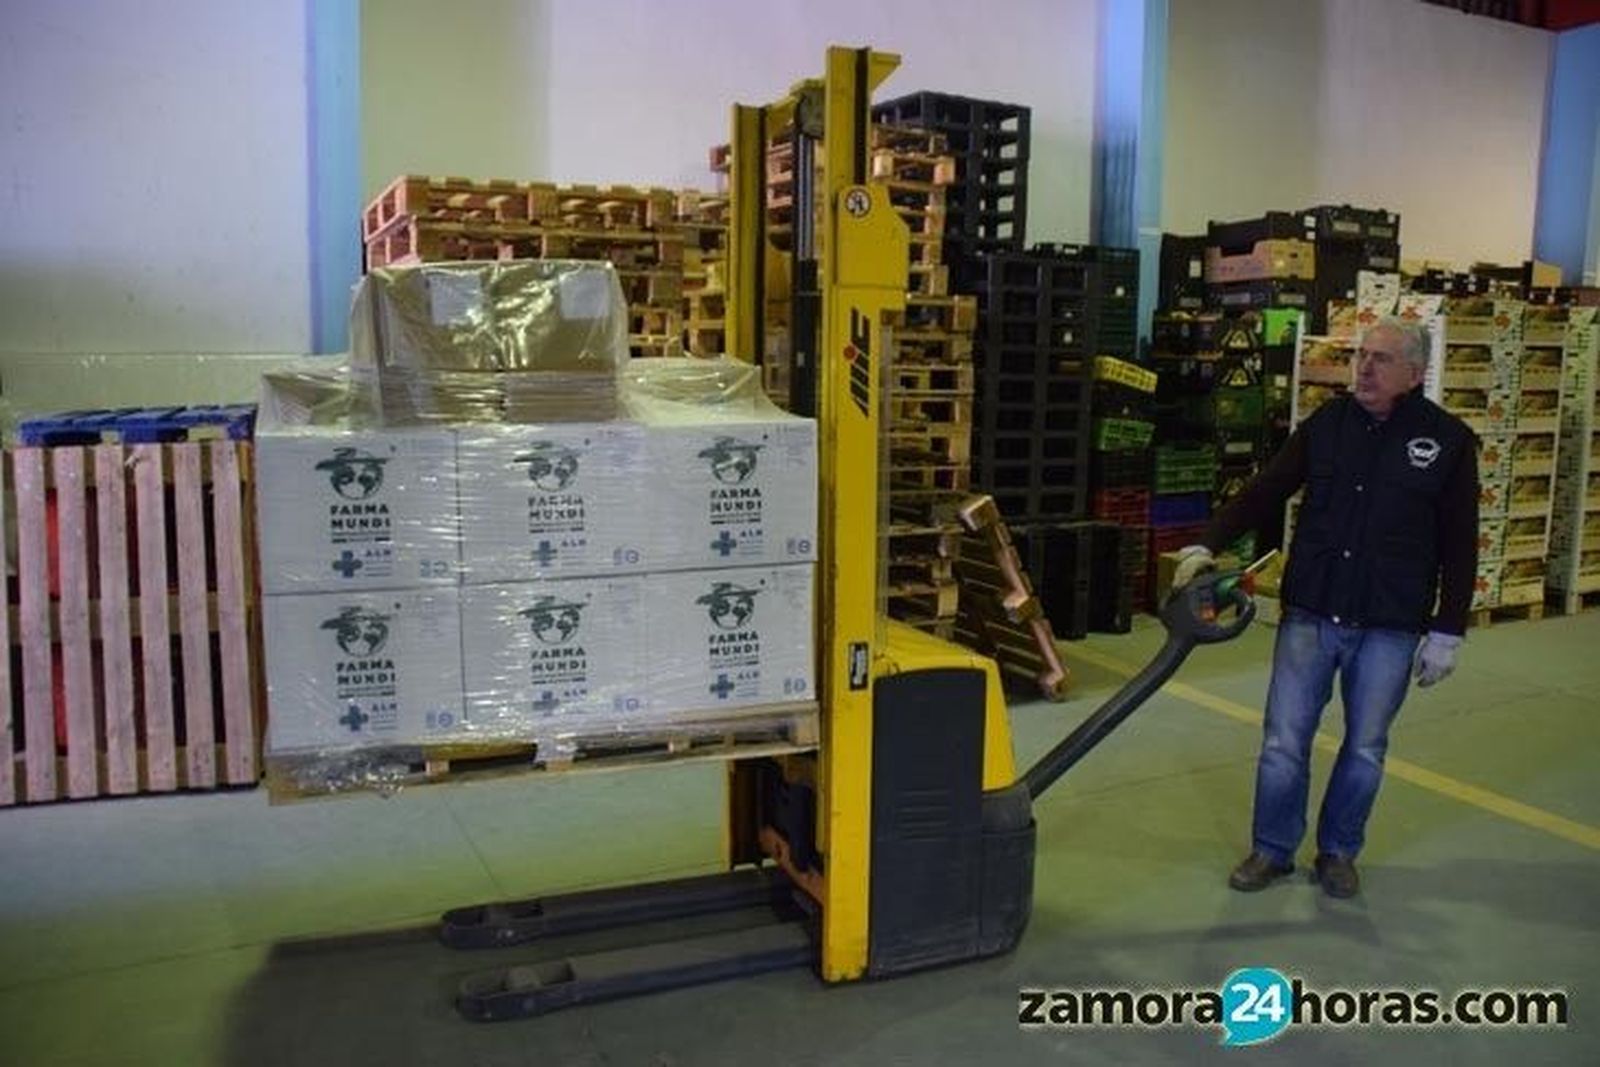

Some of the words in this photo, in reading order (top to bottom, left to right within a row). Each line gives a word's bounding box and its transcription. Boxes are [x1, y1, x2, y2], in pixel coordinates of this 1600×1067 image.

[710, 487, 762, 499] FARMA
[330, 504, 389, 515] FARMA
[710, 500, 762, 512] MUNDI
[331, 517, 391, 530] MUNDI
[708, 630, 759, 644] FARMA
[531, 647, 586, 659] FARMA
[709, 643, 760, 656] MUNDI
[336, 659, 395, 672] FARMA
[531, 659, 586, 672] MUNDI
[337, 672, 396, 685] MUNDI
